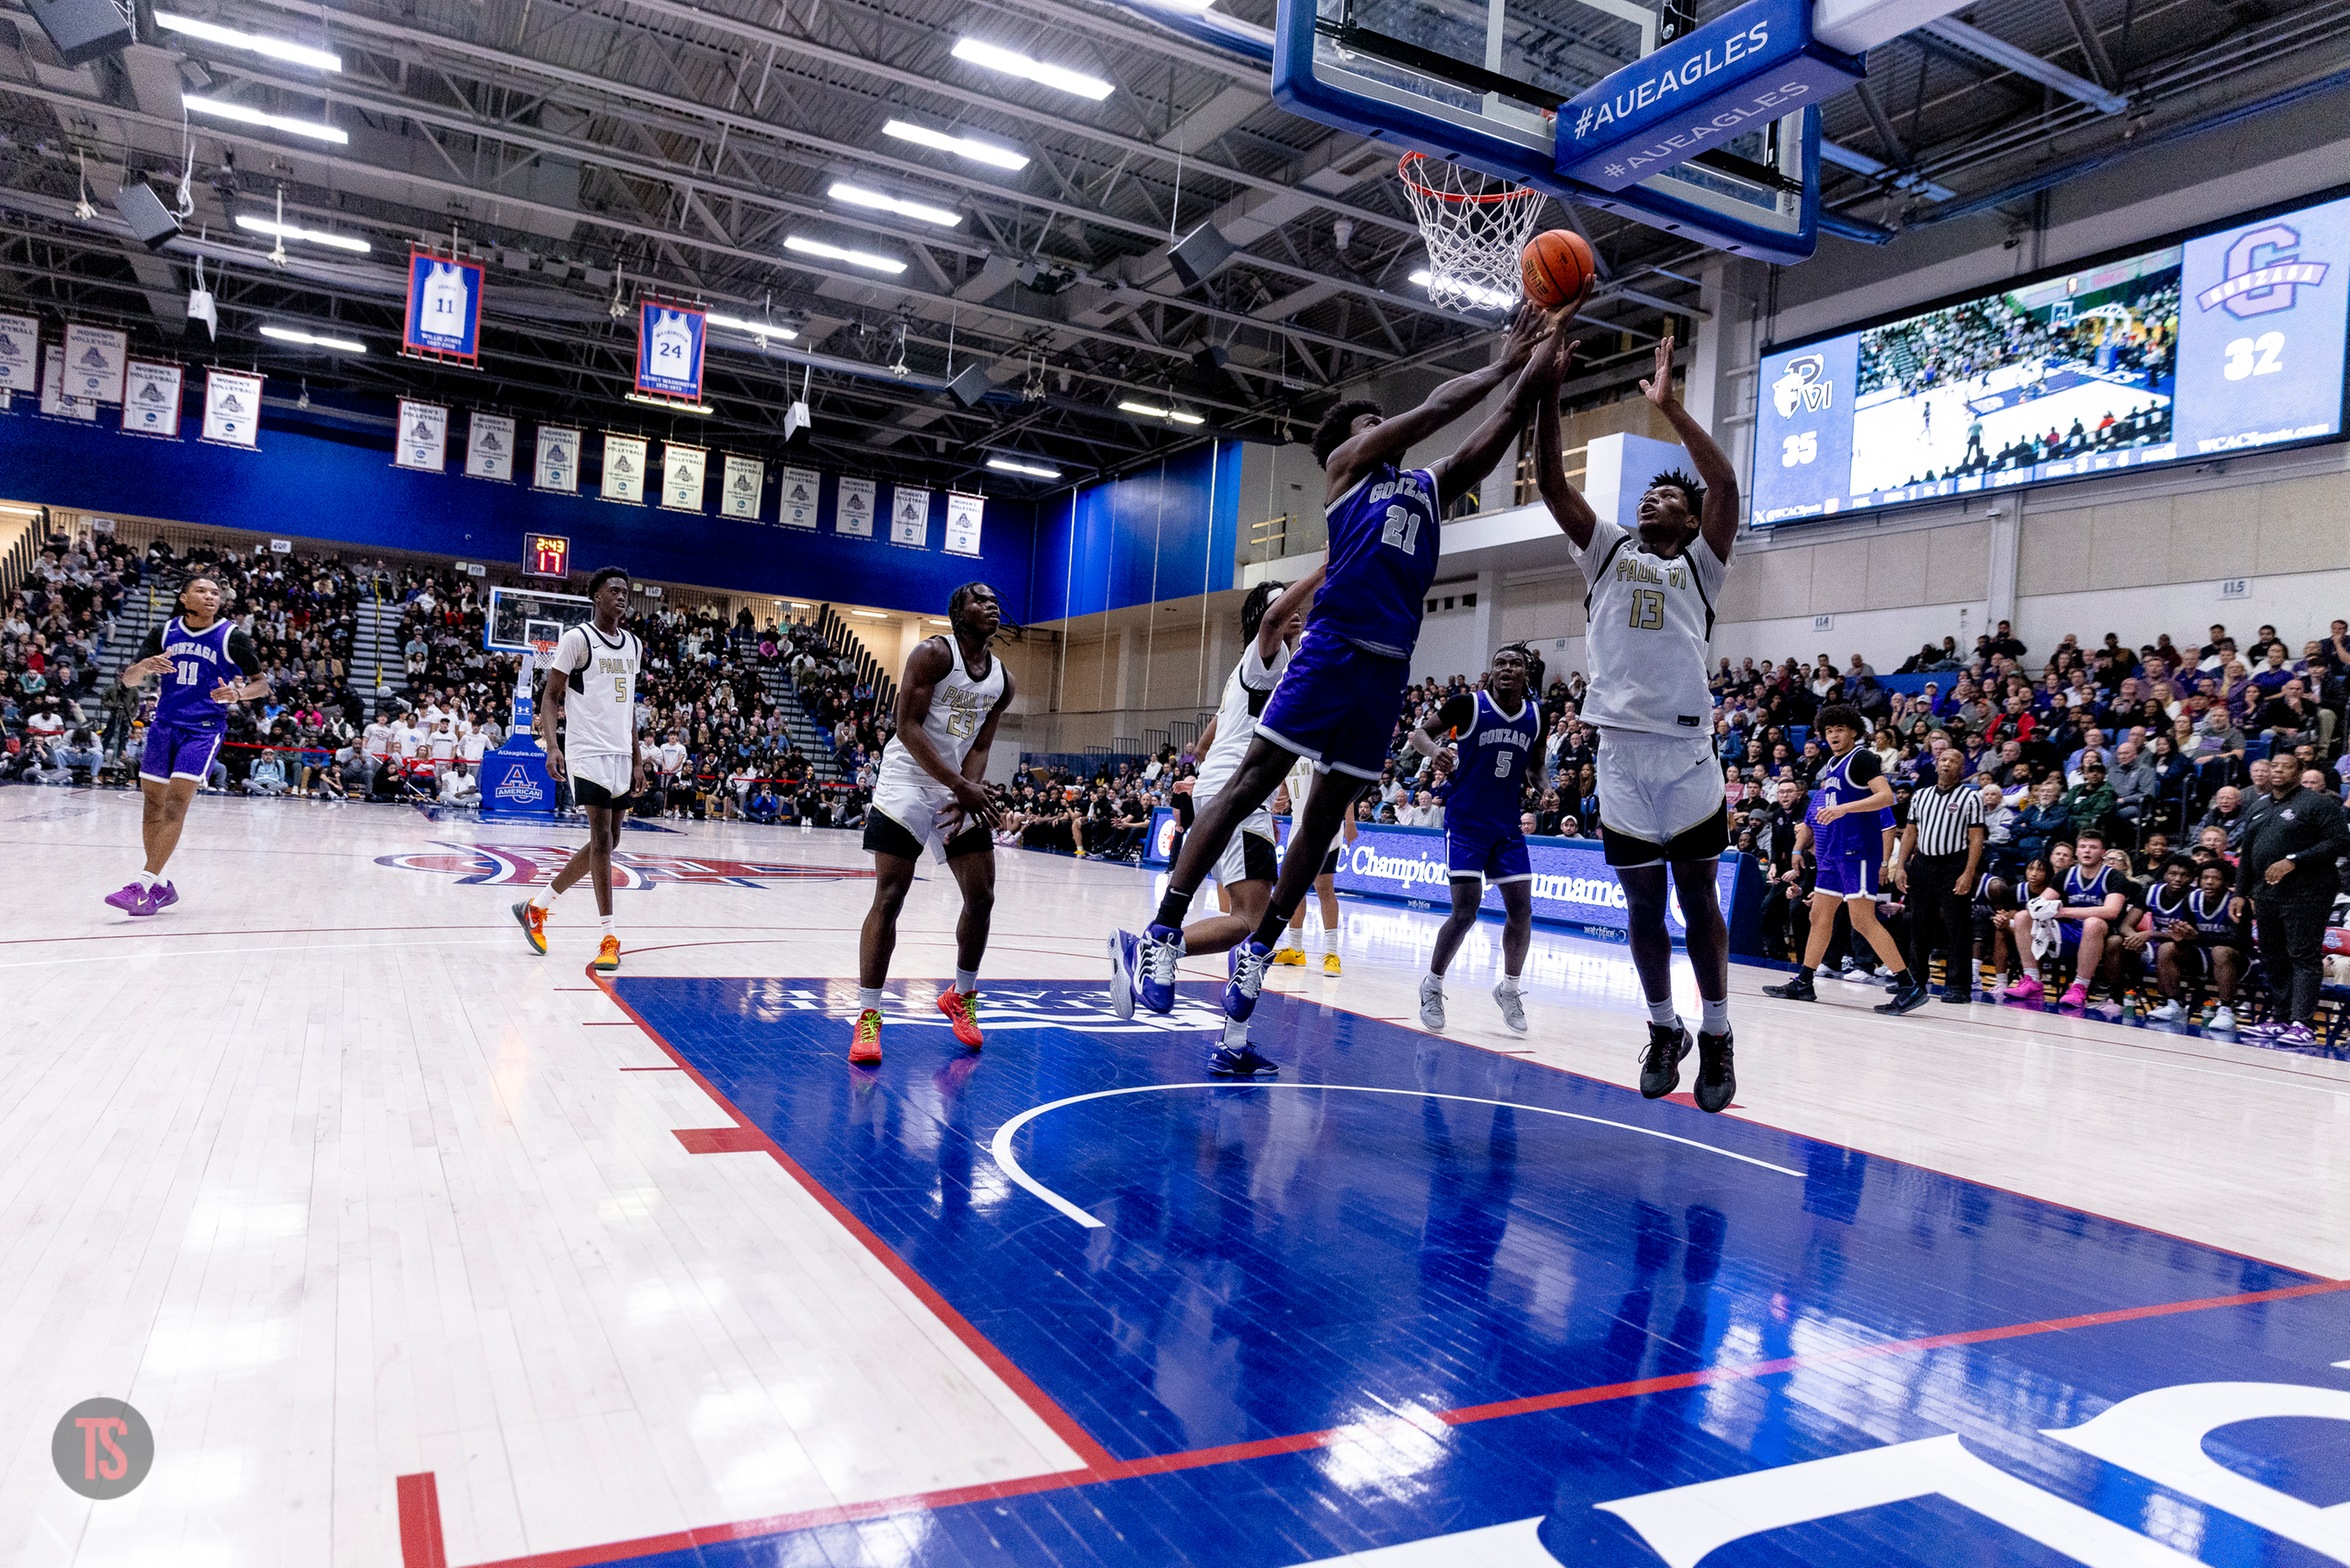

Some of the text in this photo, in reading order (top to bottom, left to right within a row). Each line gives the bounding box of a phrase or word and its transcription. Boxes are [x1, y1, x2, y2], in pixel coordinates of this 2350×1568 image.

[1574, 20, 1769, 140] #AUEAGLES
[1604, 81, 1809, 178] #AUEAGLES
[1525, 260, 1549, 295] ELITE
[2209, 265, 2314, 303] GONZAGA
[436, 298, 453, 314] 11
[0, 318, 26, 326] MEN'S
[660, 342, 682, 358] 24
[2223, 331, 2285, 381] 32
[403, 411, 444, 423] VOLLEYBALL
[408, 406, 438, 416] WOMEN'S
[472, 423, 512, 434] VOLLEYBALL
[478, 417, 507, 427] WOMEN'S
[540, 435, 578, 446] VOLLEYBALL
[544, 430, 573, 438] WOMEN'S
[2197, 423, 2329, 453] WCACSports.com
[606, 446, 644, 456] VOLLEYBALL
[611, 441, 639, 449] WOMEN'S
[1782, 430, 1818, 468] 35
[667, 456, 703, 466] VOLLEYBALL
[731, 460, 757, 469] WOMEN'S
[726, 465, 762, 475] VOLLEYBALL
[789, 470, 814, 478] WOMEN'S
[784, 475, 819, 485] VOLLEYBALL
[844, 480, 869, 488] WOMEN'S
[840, 486, 874, 494] VOLLEYBALL
[900, 491, 923, 499] WOMEN'S
[895, 496, 927, 504] VOLLEYBALL
[950, 505, 981, 513] VOLLEYBALL
[1381, 504, 1420, 556] 21
[536, 538, 565, 553] 2:43
[540, 552, 560, 573] 17
[1617, 558, 1686, 590] PAUL VI
[2224, 581, 2245, 593] 115
[1629, 588, 1665, 631] 13
[1816, 616, 1829, 626] 114
[168, 642, 217, 665] ONZAGA
[599, 658, 627, 674] PAUL
[176, 660, 199, 686] 11
[614, 677, 627, 702] 5
[941, 685, 979, 709] PAUL
[946, 706, 978, 740] 23
[498, 749, 545, 758] AUeagles.com
[1494, 750, 1513, 778] 5
[498, 788, 541, 797] AMERICAN
[1293, 778, 1300, 799] 1
[1531, 871, 1628, 910] urname
